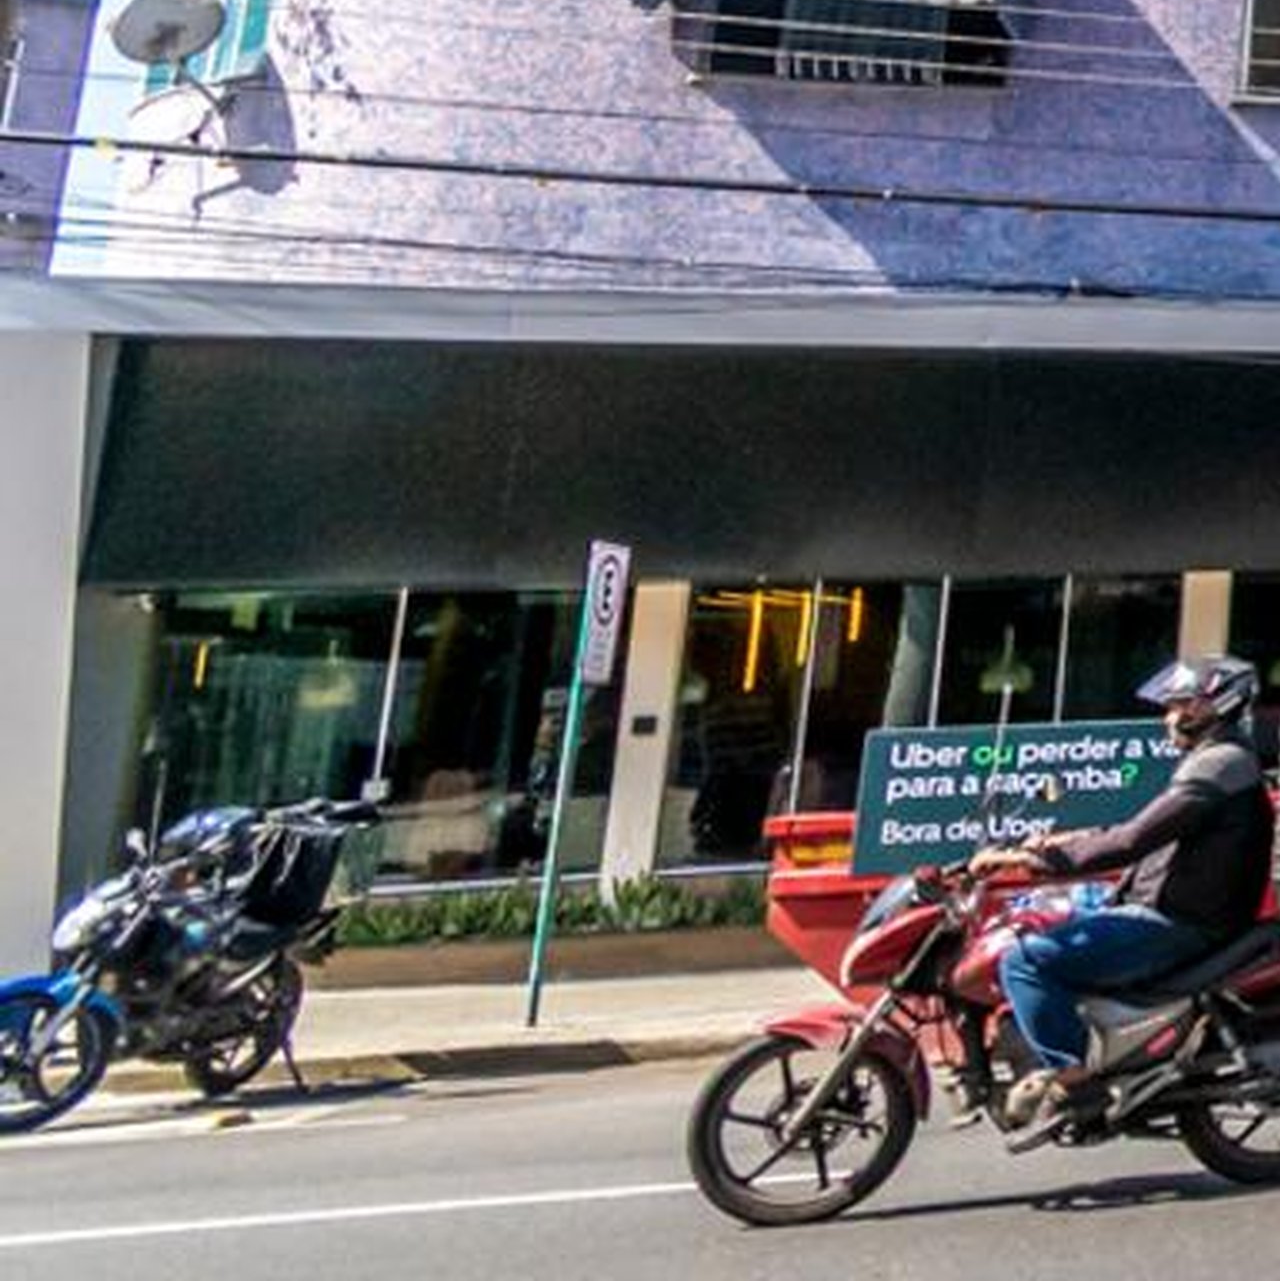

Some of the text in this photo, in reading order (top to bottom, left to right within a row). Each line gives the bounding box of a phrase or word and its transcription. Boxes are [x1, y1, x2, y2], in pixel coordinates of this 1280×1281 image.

[889, 742, 967, 770] Uber
[972, 745, 1014, 766] ou
[1017, 735, 1120, 770] perder
[1123, 737, 1144, 759] a
[886, 775, 955, 805] para
[960, 774, 980, 796] a
[880, 820, 942, 845] Bora
[945, 816, 984, 841] de
